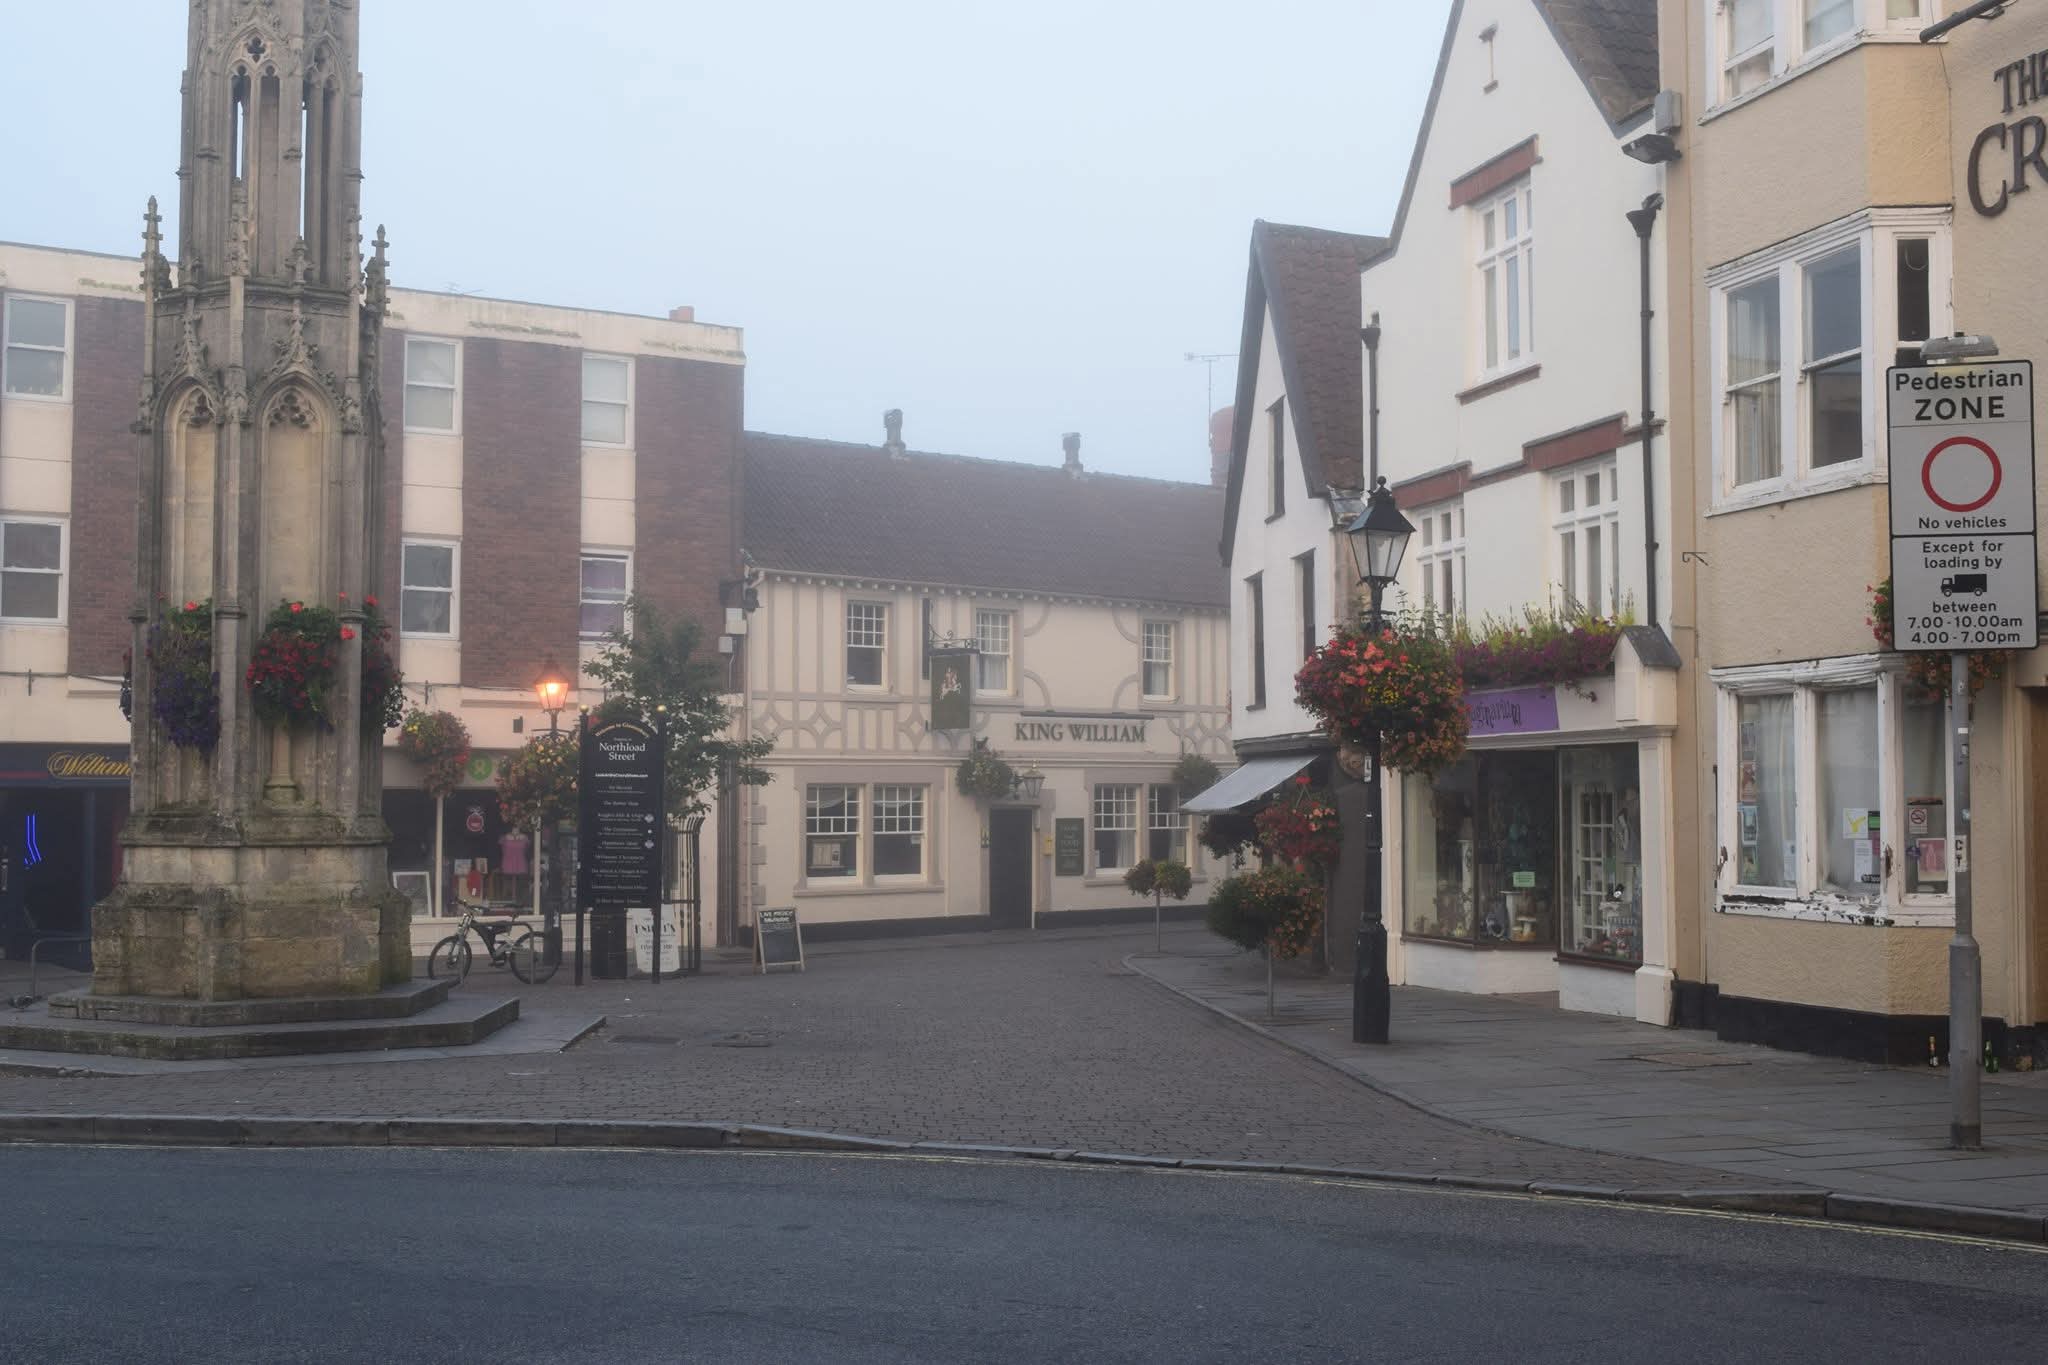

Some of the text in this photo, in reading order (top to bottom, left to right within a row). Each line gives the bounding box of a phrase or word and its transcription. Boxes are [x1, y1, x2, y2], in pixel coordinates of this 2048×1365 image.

[1895, 370, 2023, 391] Pedestrian
[1915, 395, 2005, 421] ZONE
[1919, 516, 2007, 529] No vehicles
[1922, 540, 2003, 554] Except for
[1924, 555, 2003, 569] loading by
[1932, 601, 1997, 613] between
[1015, 722, 1146, 742] KING WILLIAM
[599, 742, 646, 752] Northload
[608, 751, 636, 761] Street
